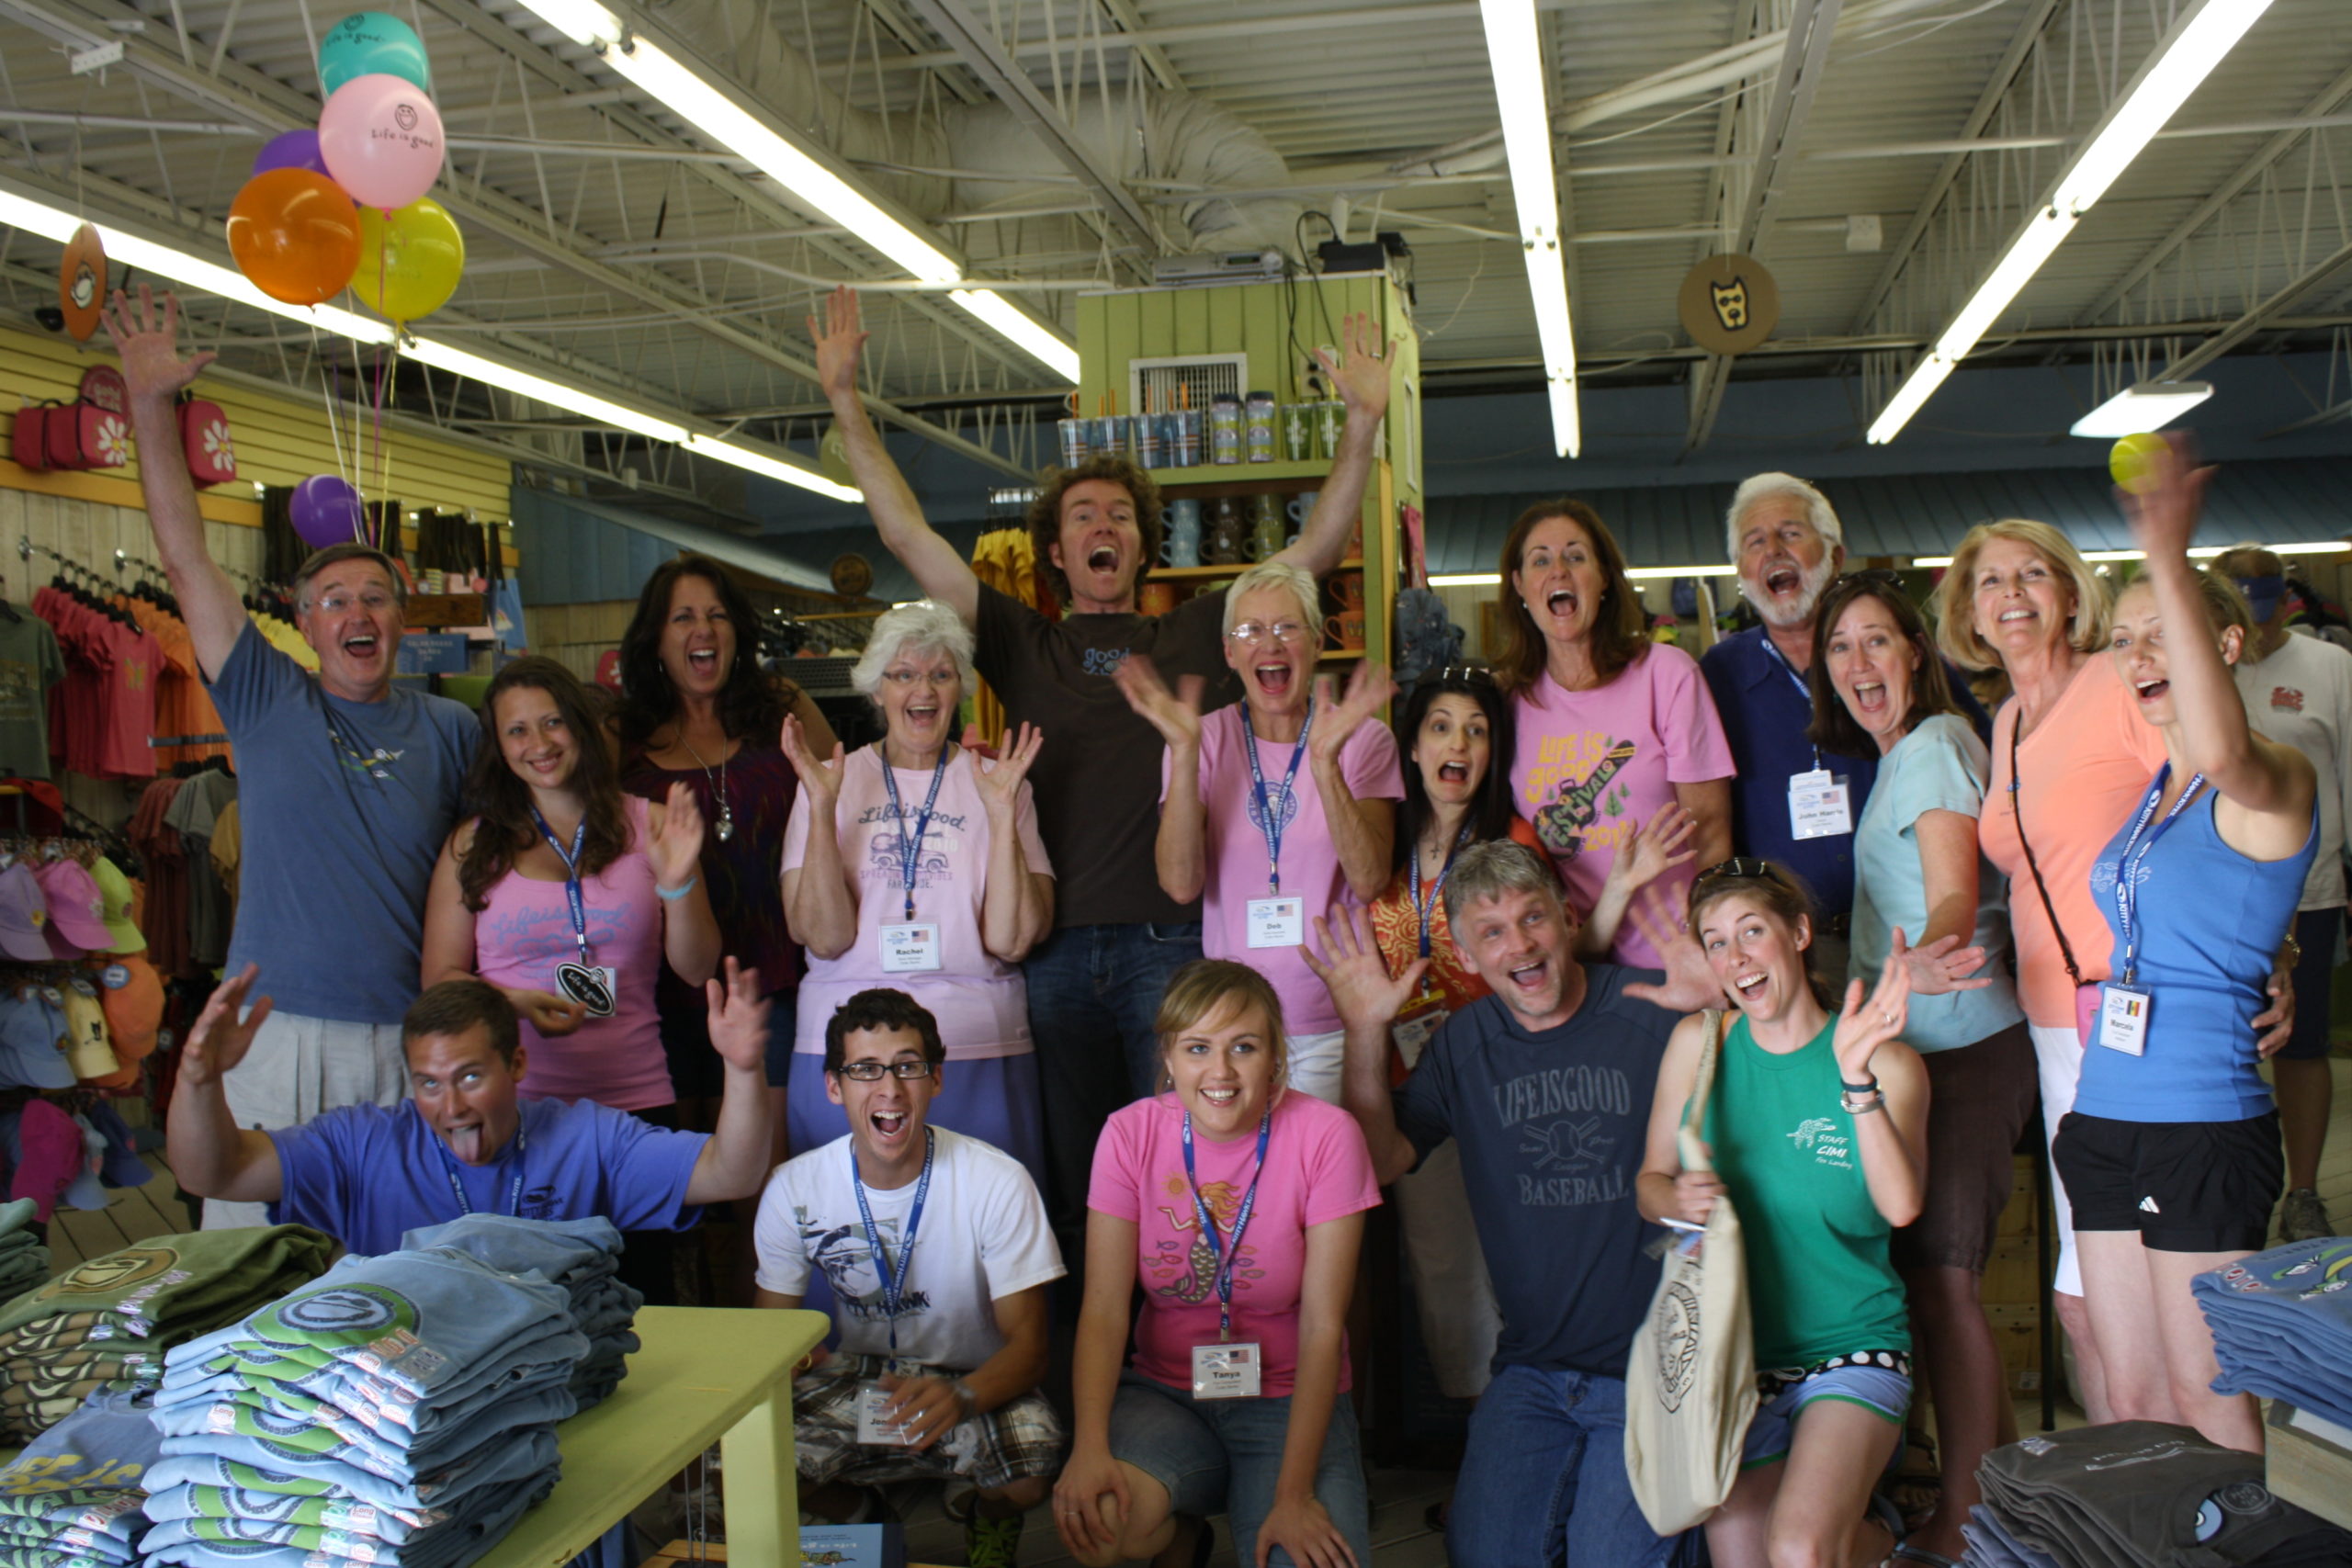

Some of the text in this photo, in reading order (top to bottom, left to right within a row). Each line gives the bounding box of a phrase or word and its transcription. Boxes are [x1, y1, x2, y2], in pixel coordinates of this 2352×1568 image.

[371, 128, 435, 149] Life is good
[1538, 733, 1578, 765] LIFE
[2138, 807, 2153, 824] KITTY
[2117, 903, 2130, 924] KITTY
[566, 971, 582, 987] Life
[583, 988, 607, 1007] good
[1817, 1134, 1849, 1145] STAFF
[1517, 1165, 1630, 1206] BASEBALL
[855, 1182, 879, 1241] KITTY HAWK KITES
[1231, 1224, 1243, 1244] KITTY
[1238, 1203, 1250, 1225] HAWK
[899, 1247, 910, 1269] KITTY
[1213, 1371, 1241, 1380] Tanya
[353, 1506, 374, 1516] Long
